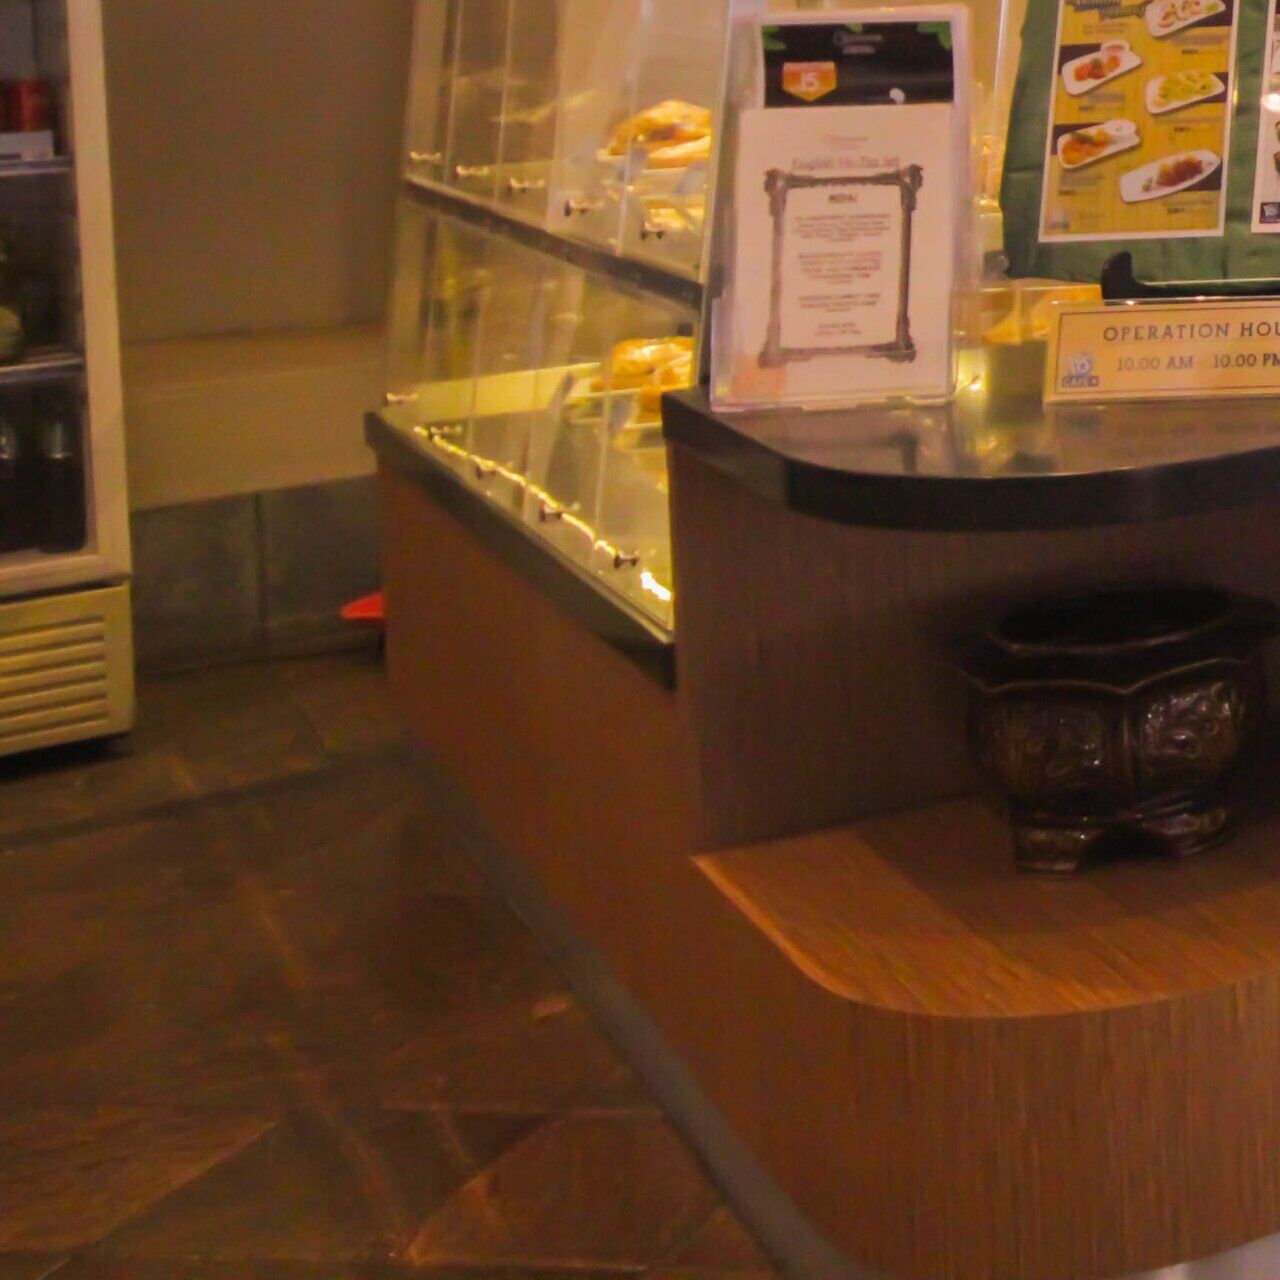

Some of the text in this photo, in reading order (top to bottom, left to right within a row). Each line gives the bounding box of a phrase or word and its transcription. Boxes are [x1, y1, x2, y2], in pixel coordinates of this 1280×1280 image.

[1102, 323, 1229, 342] OPERATION
[1117, 356, 1161, 371] 10.00
[1165, 355, 1194, 370] AM
[1213, 353, 1257, 368] 10.00
